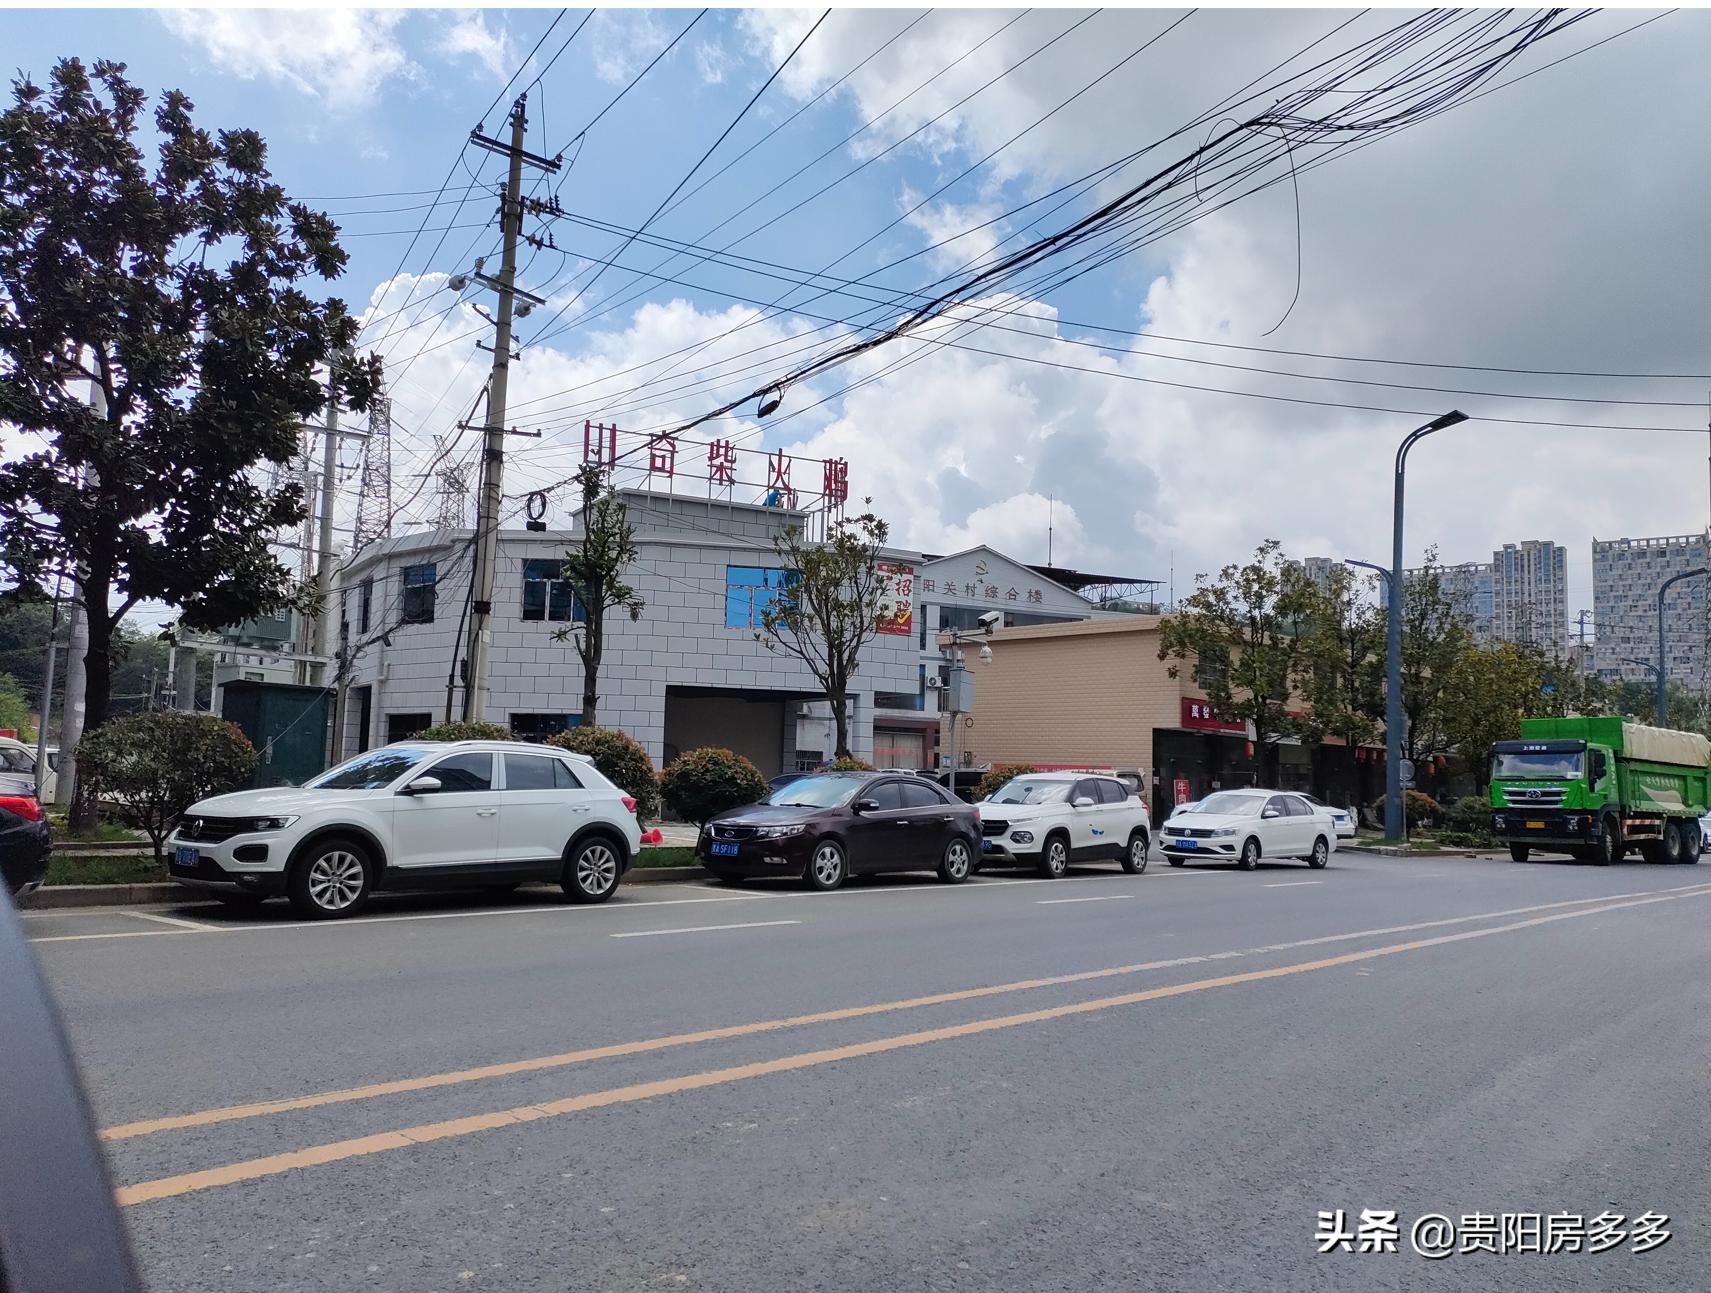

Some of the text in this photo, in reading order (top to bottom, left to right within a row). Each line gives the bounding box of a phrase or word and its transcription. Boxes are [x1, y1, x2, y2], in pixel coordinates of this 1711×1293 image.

[923, 579, 1043, 603] 阳关村综合楼
